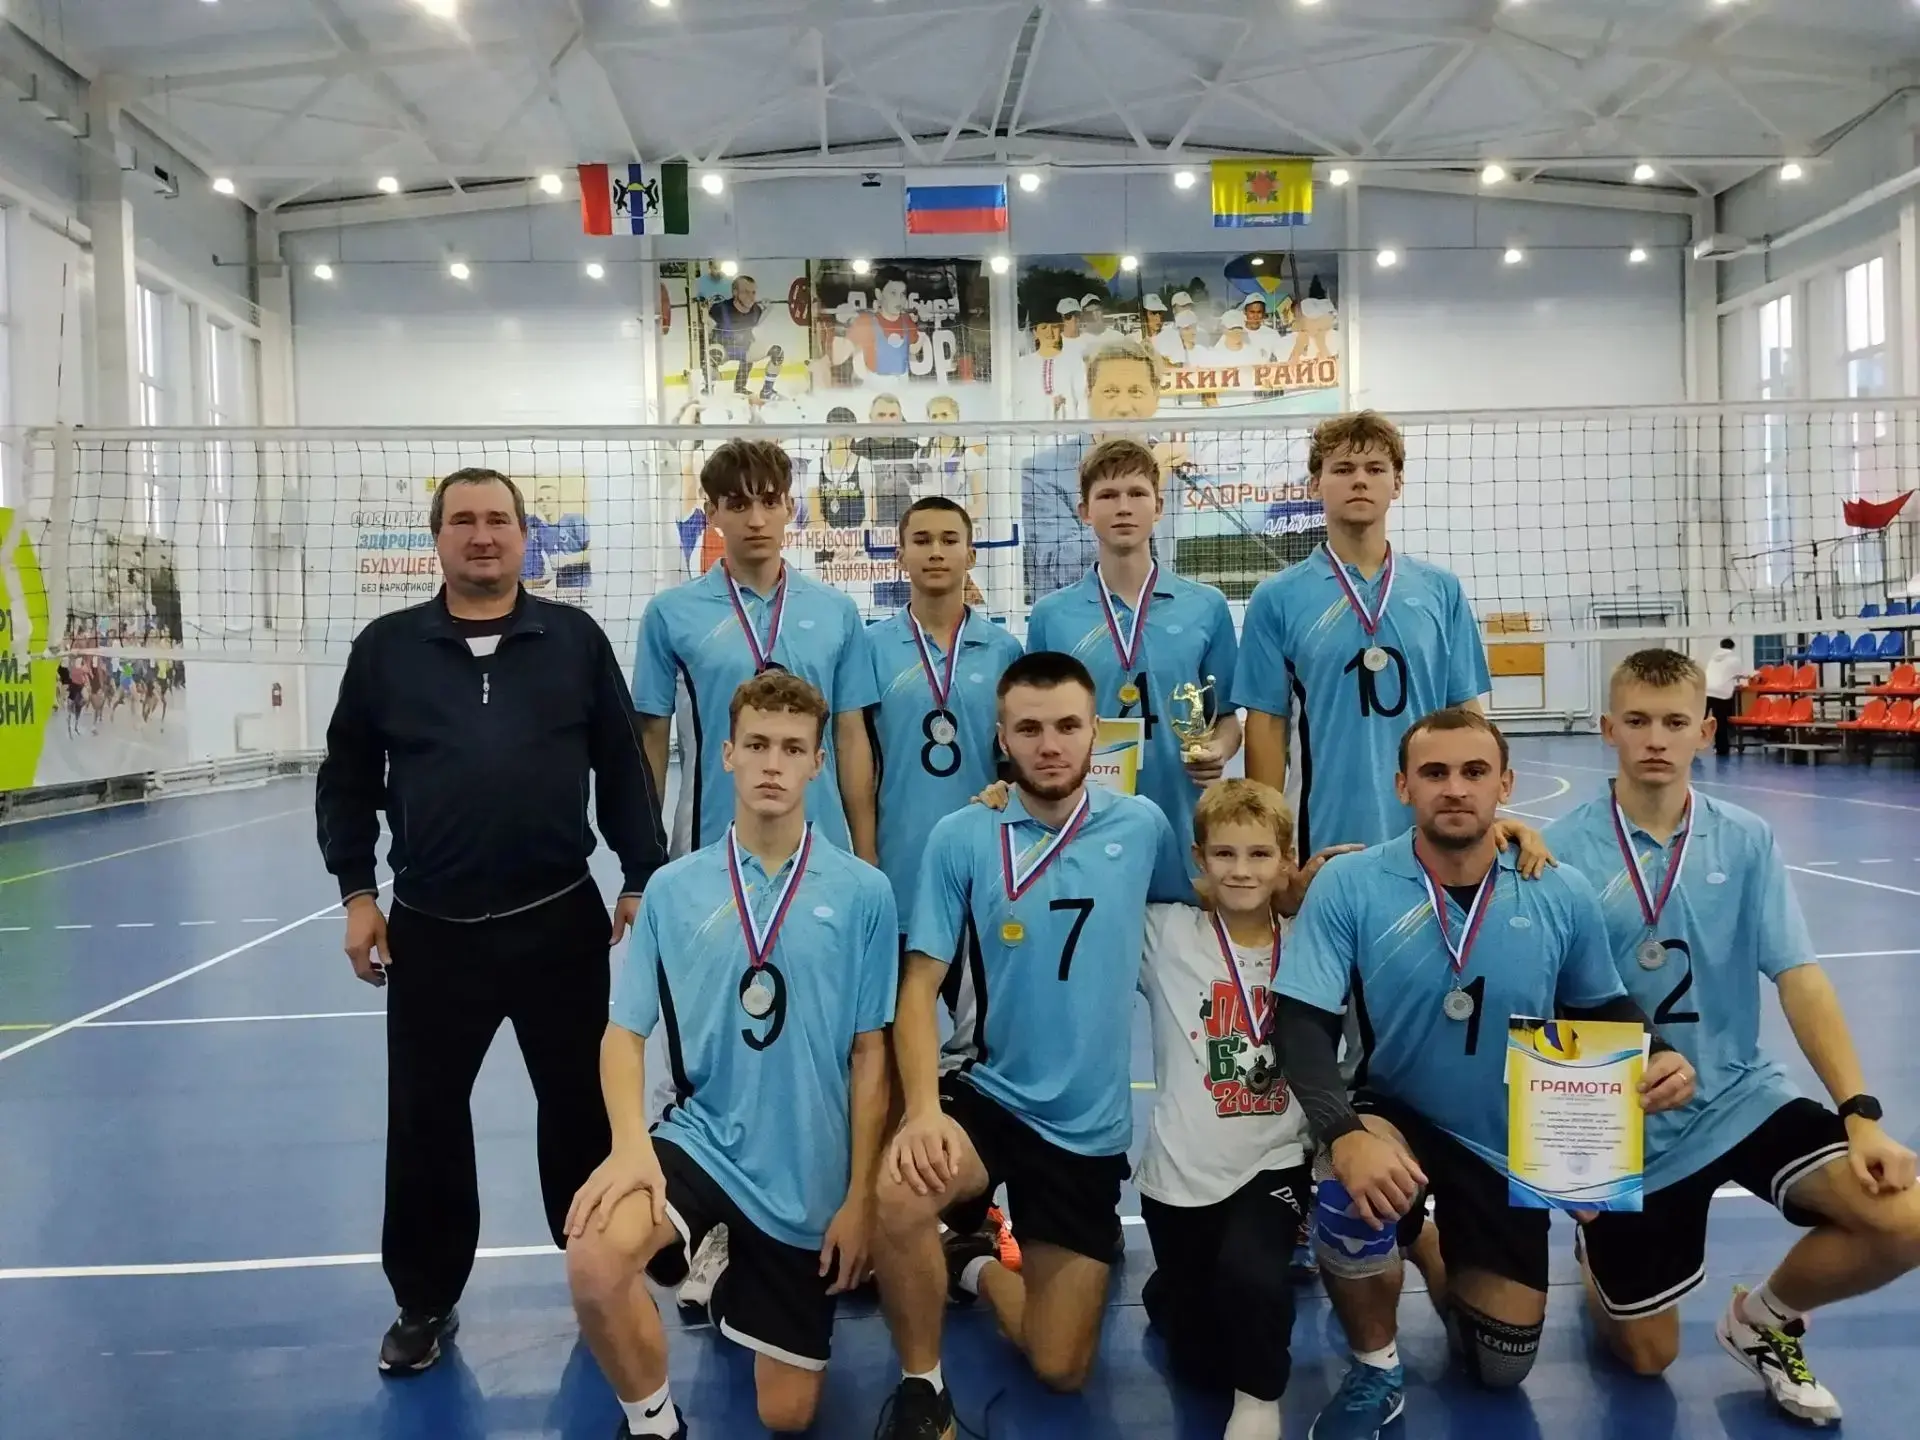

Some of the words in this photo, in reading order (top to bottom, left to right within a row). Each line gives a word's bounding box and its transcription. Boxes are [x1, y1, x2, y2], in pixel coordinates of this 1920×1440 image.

[361, 557, 437, 577] БУДУЩЕЕ
[361, 583, 377, 593] БЕЗ
[1344, 646, 1407, 717] 10
[921, 709, 961, 777] 8
[1088, 765, 1120, 775] ОТА
[1049, 898, 1095, 981] 7
[739, 961, 787, 1051] 9
[1653, 939, 1700, 1024] 2
[1461, 976, 1486, 1056] 1
[1211, 1079, 1290, 1118] 2023
[1530, 1079, 1622, 1095] ГРАМОТА
